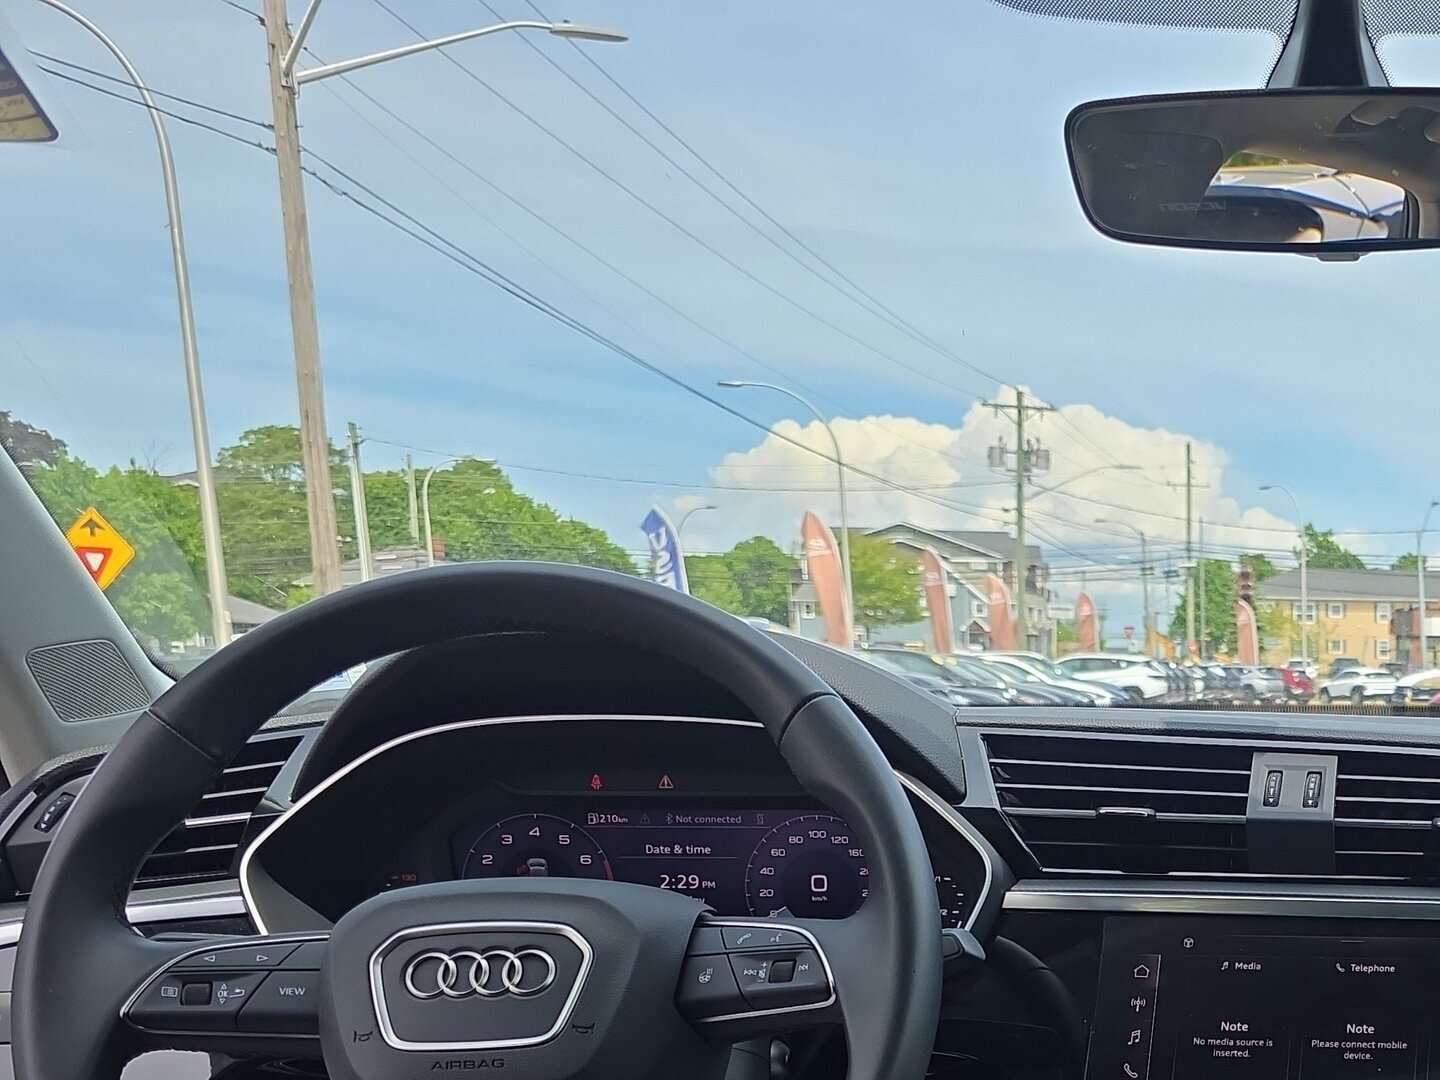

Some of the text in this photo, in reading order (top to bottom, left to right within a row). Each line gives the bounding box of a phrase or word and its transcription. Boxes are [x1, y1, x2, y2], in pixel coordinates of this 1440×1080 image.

[675, 815, 742, 825] Not connected
[529, 826, 541, 837] 4
[808, 830, 827, 839] 100
[500, 834, 513, 845] 3
[558, 834, 571, 845] 5
[830, 835, 849, 844] 120
[645, 843, 712, 855] Date & time
[770, 848, 786, 857] 60
[481, 854, 494, 865] 2
[579, 854, 592, 865] 6
[759, 866, 775, 876] 40
[659, 873, 716, 889] 2:29 PM
[810, 874, 828, 892] 0
[759, 888, 774, 898] 20
[1234, 961, 1262, 972] Media
[1350, 962, 1396, 975] Telephone
[279, 986, 306, 996] VIEW
[1220, 1020, 1249, 1032] Note
[1346, 1022, 1375, 1035] Note
[1193, 1037, 1273, 1048] No media source is
[1311, 1039, 1408, 1051] Please connect mobile
[1343, 1049, 1374, 1061] device.
[430, 1057, 506, 1071] AIRBAG
